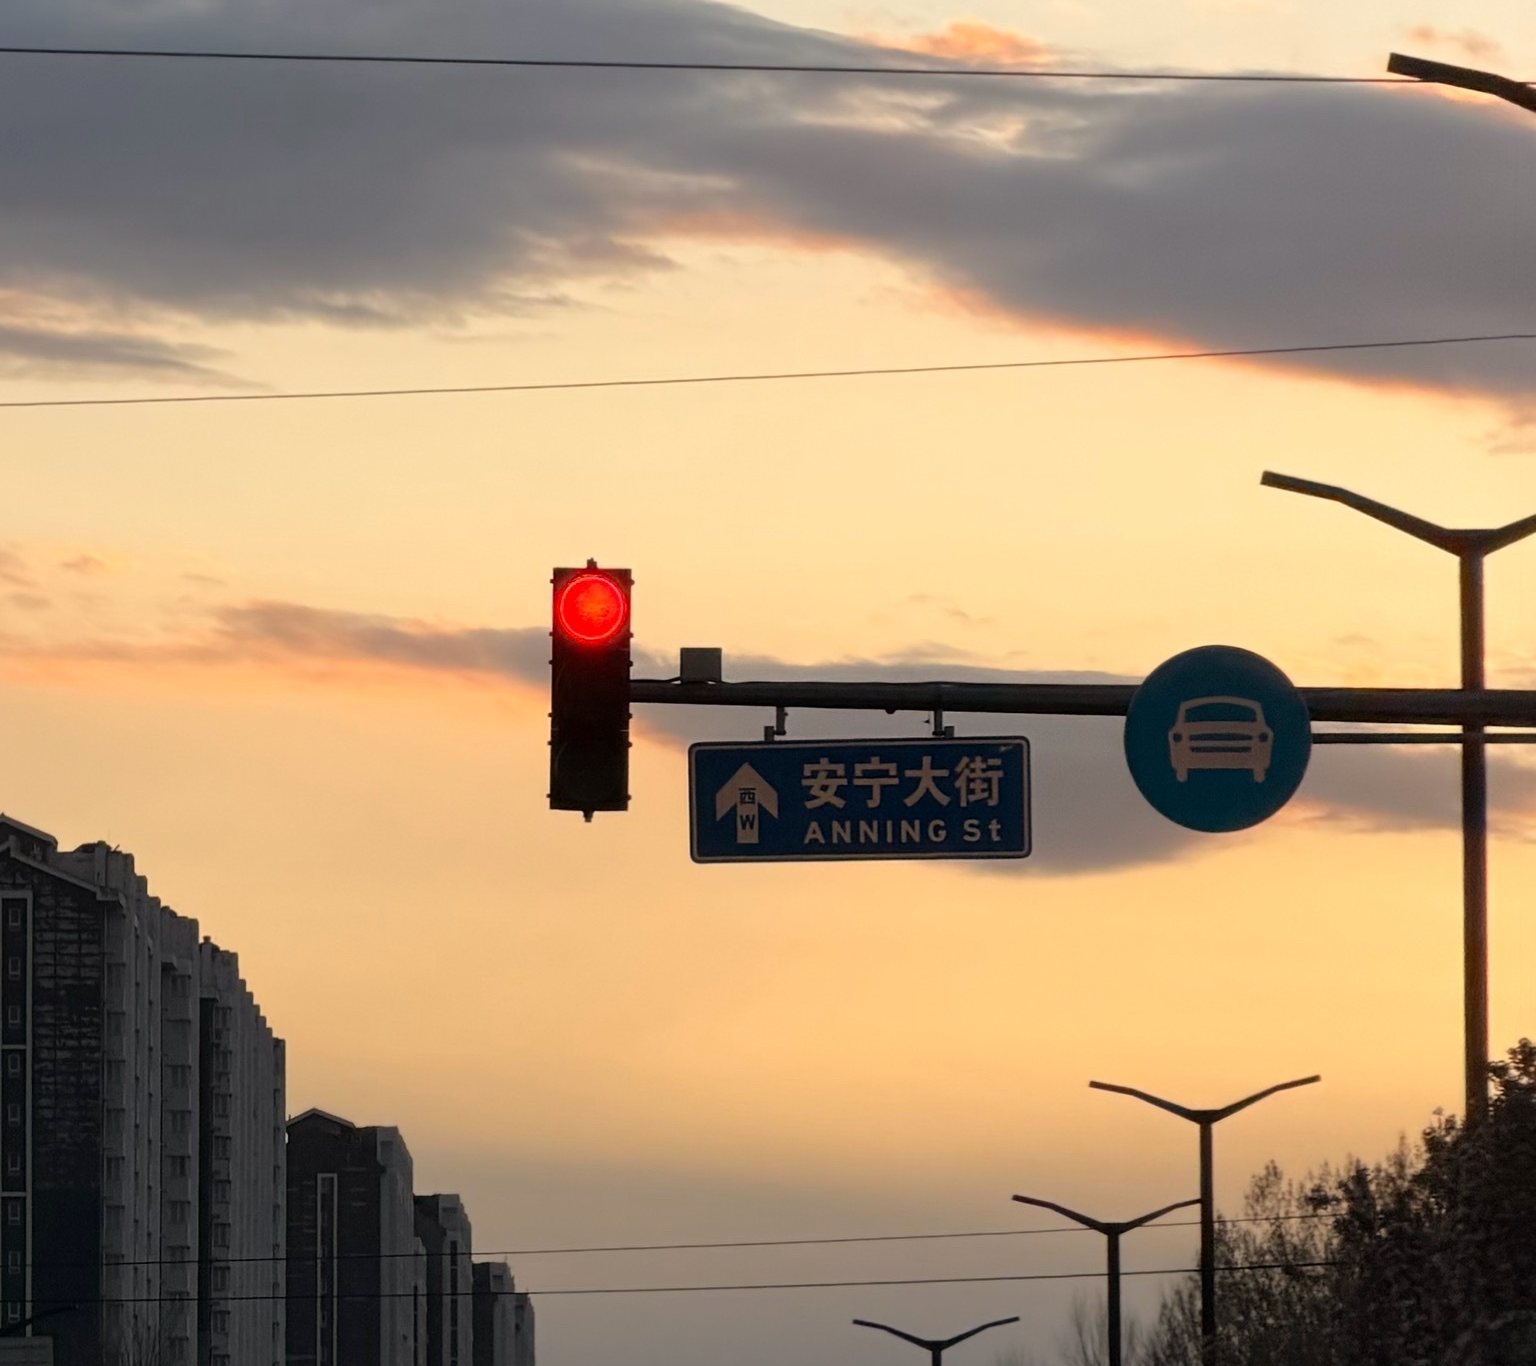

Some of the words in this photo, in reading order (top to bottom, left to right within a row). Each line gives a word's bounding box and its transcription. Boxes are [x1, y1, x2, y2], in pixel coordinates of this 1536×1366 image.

[801, 755, 1004, 809] 安宁大街
[739, 787, 756, 805] 西
[740, 815, 755, 830] W
[803, 818, 947, 844] ANNING
[963, 818, 1001, 842] St
